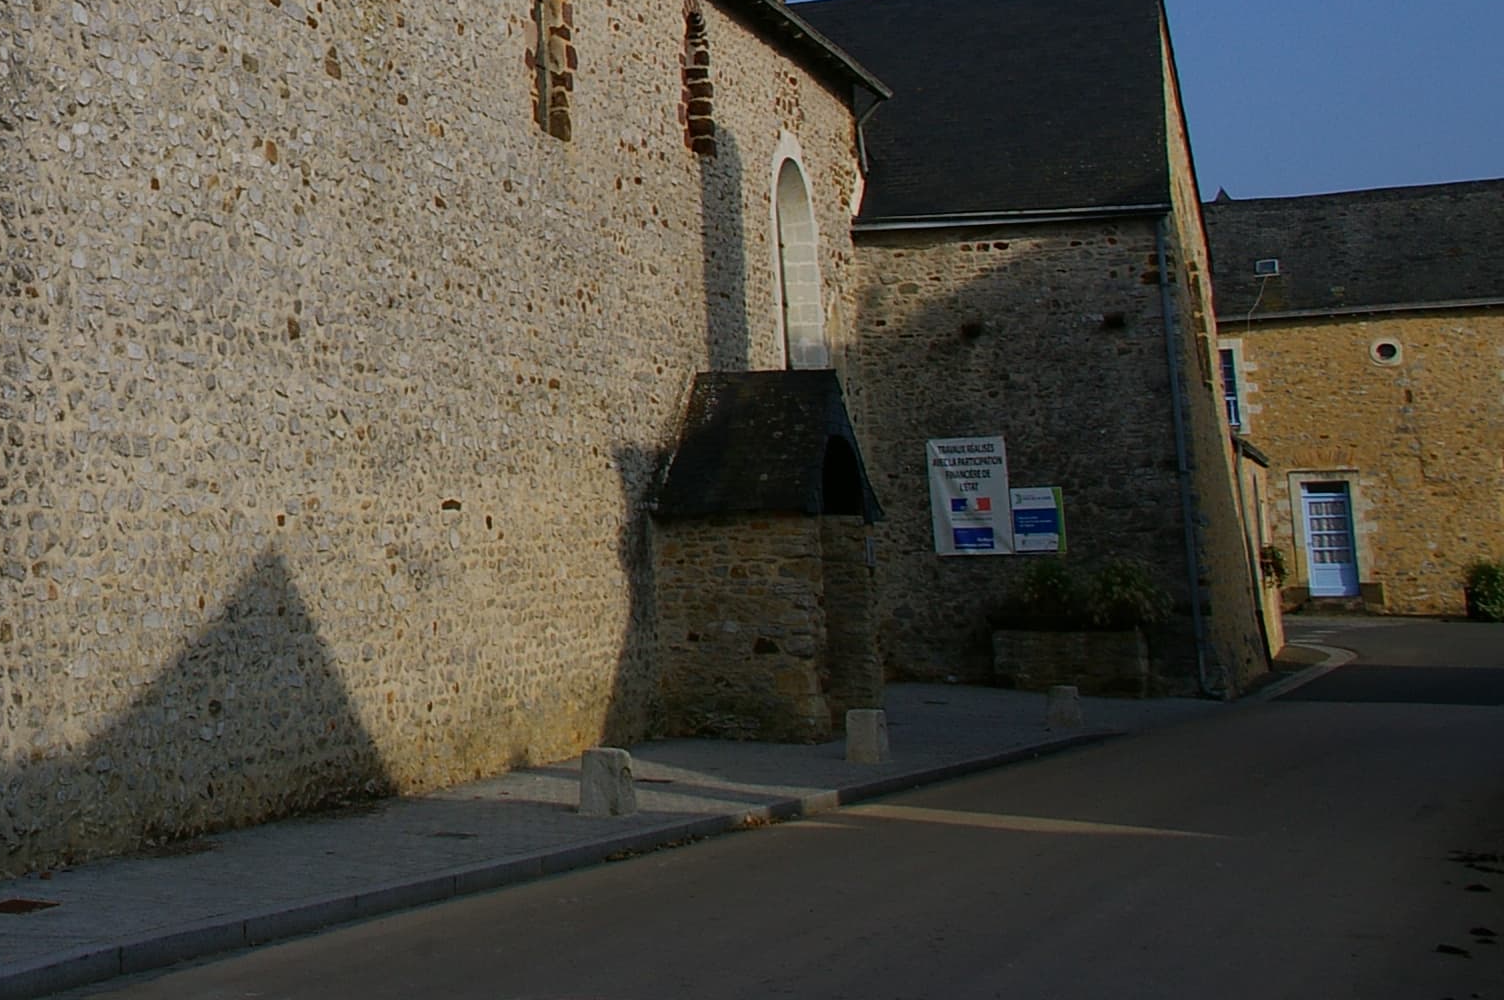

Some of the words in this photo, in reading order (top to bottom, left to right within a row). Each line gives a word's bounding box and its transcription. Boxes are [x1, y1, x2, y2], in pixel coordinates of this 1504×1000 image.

[937, 445, 965, 453] TRAVAUX
[957, 456, 1002, 465] PARTICIPATION
[982, 469, 991, 478] DE
